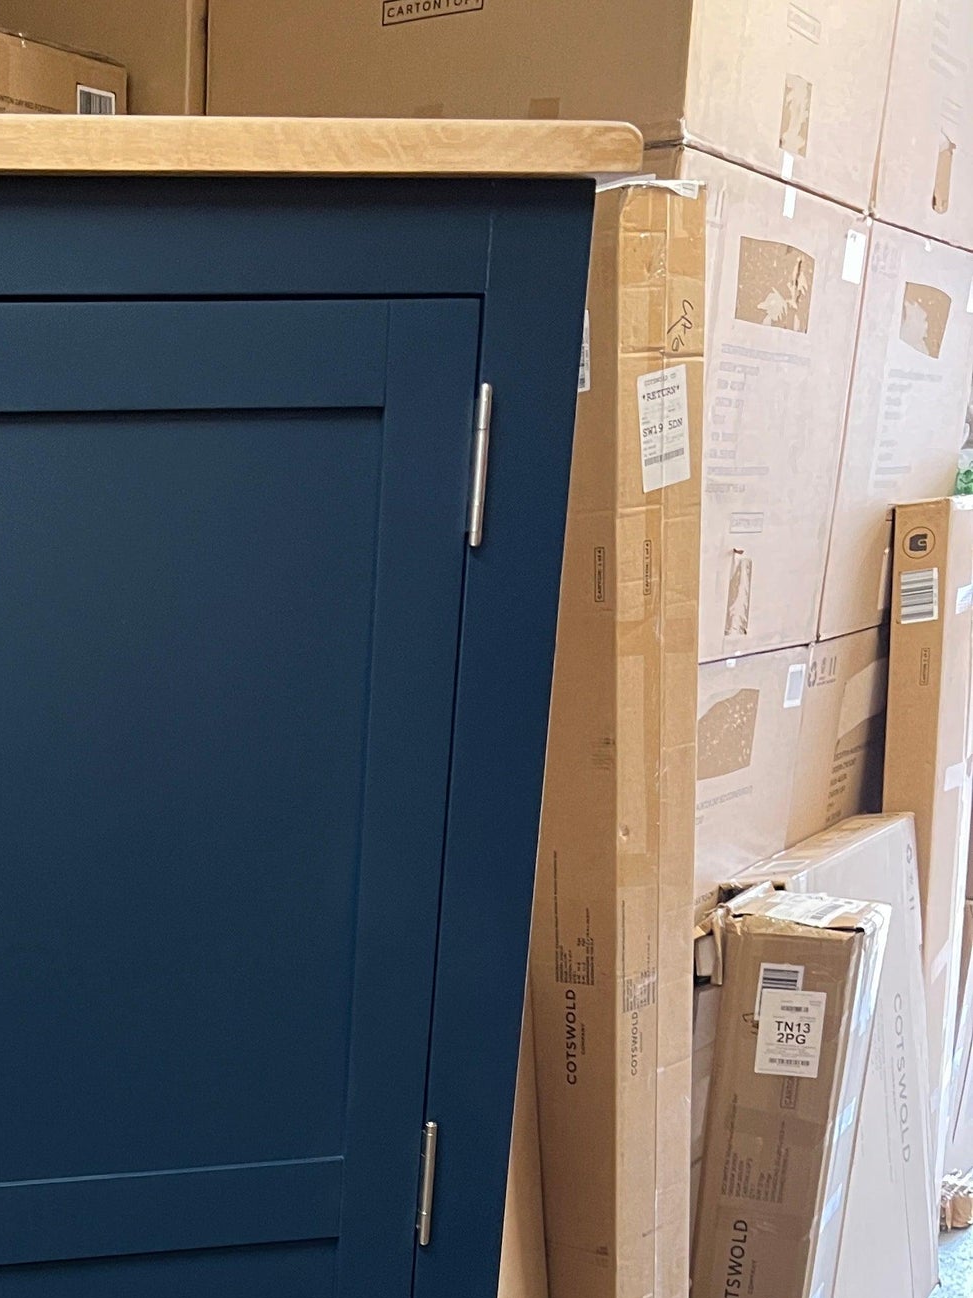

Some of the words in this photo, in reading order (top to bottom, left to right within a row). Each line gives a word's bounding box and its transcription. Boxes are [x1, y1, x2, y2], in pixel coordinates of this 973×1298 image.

[387, 0, 441, 18] CARTON
[566, 989, 577, 1086] COTSWOLD
[630, 1011, 639, 1076] COTSWOLD
[775, 1020, 811, 1034] TN13
[776, 1033, 807, 1045] 2PG
[893, 992, 912, 1164] COTSWOLD
